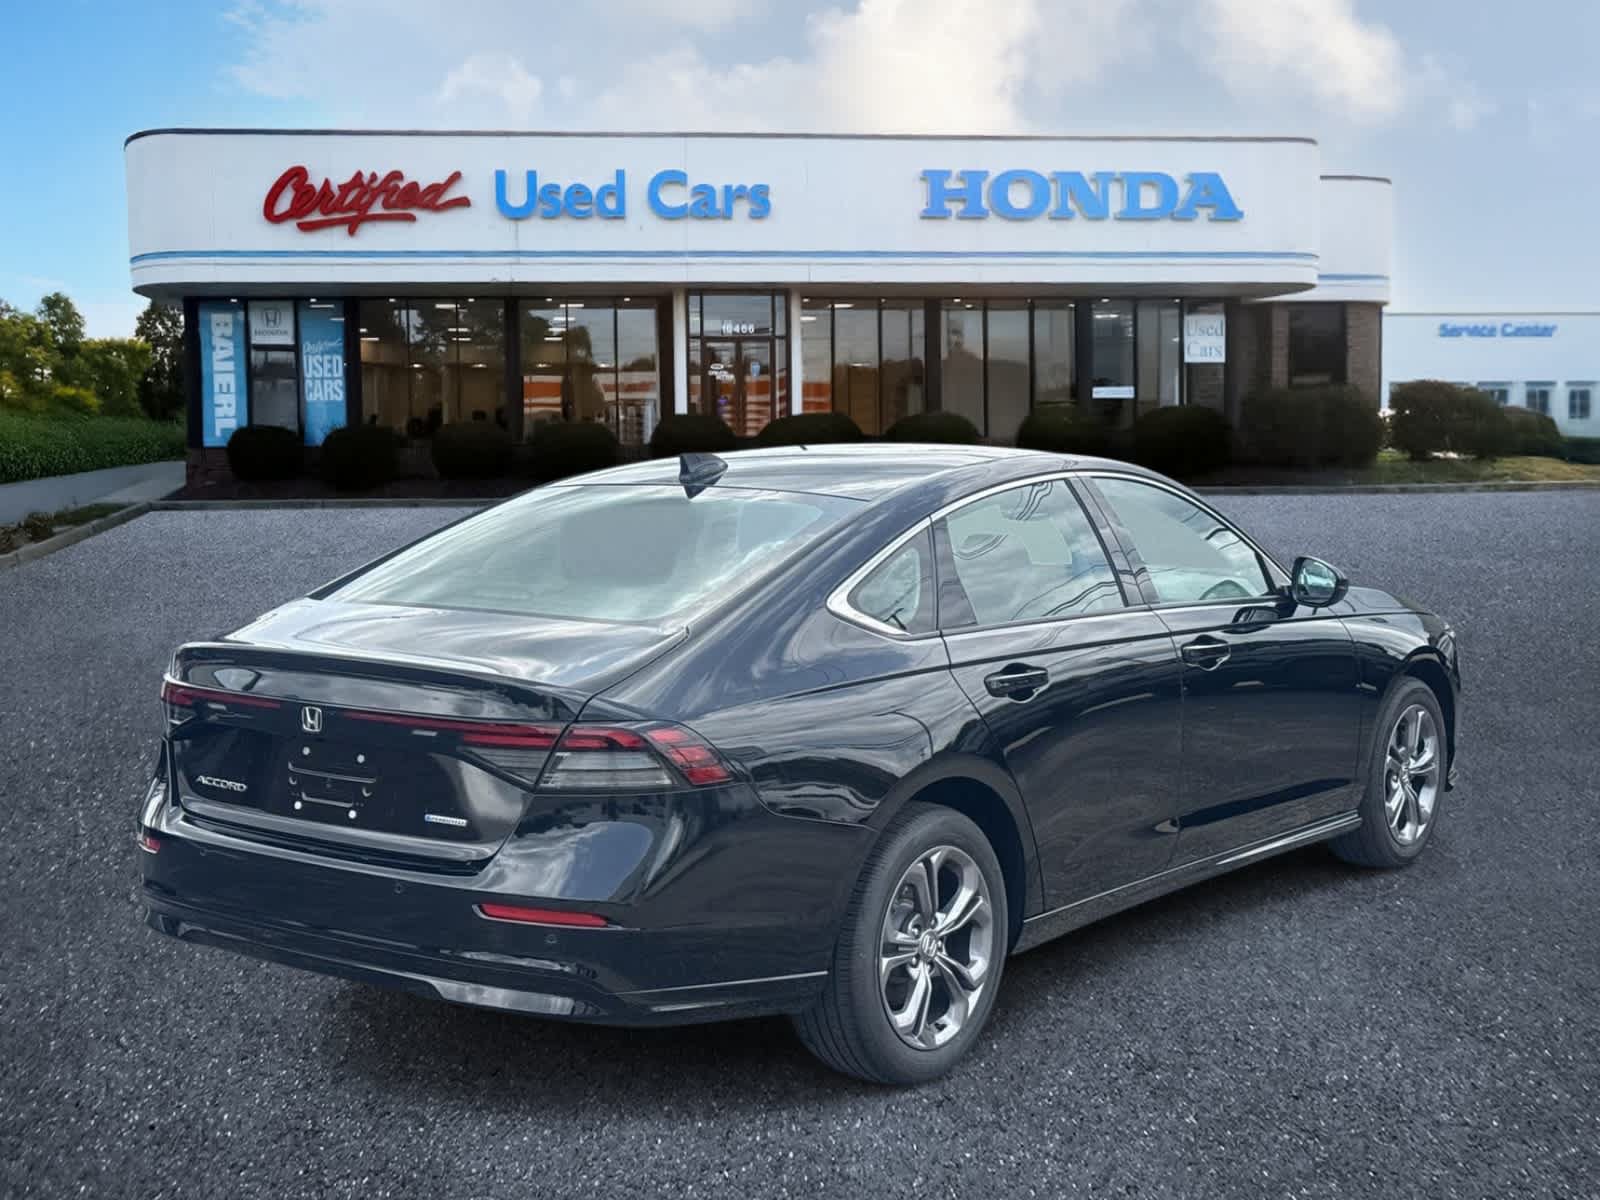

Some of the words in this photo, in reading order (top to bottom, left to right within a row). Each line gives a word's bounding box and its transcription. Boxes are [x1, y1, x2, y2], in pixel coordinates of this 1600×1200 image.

[263, 165, 471, 236] Certified
[494, 168, 626, 220] Used
[647, 168, 771, 220] Cars
[919, 168, 1245, 221] HONDA
[1185, 318, 1224, 337] Used
[1438, 322, 1497, 337] Service
[1501, 322, 1557, 337] Center
[1186, 341, 1224, 358] Cars
[210, 313, 237, 438] BAIERL
[303, 355, 343, 378] USED
[304, 379, 344, 401] CARS
[195, 775, 248, 792] ACCORD
